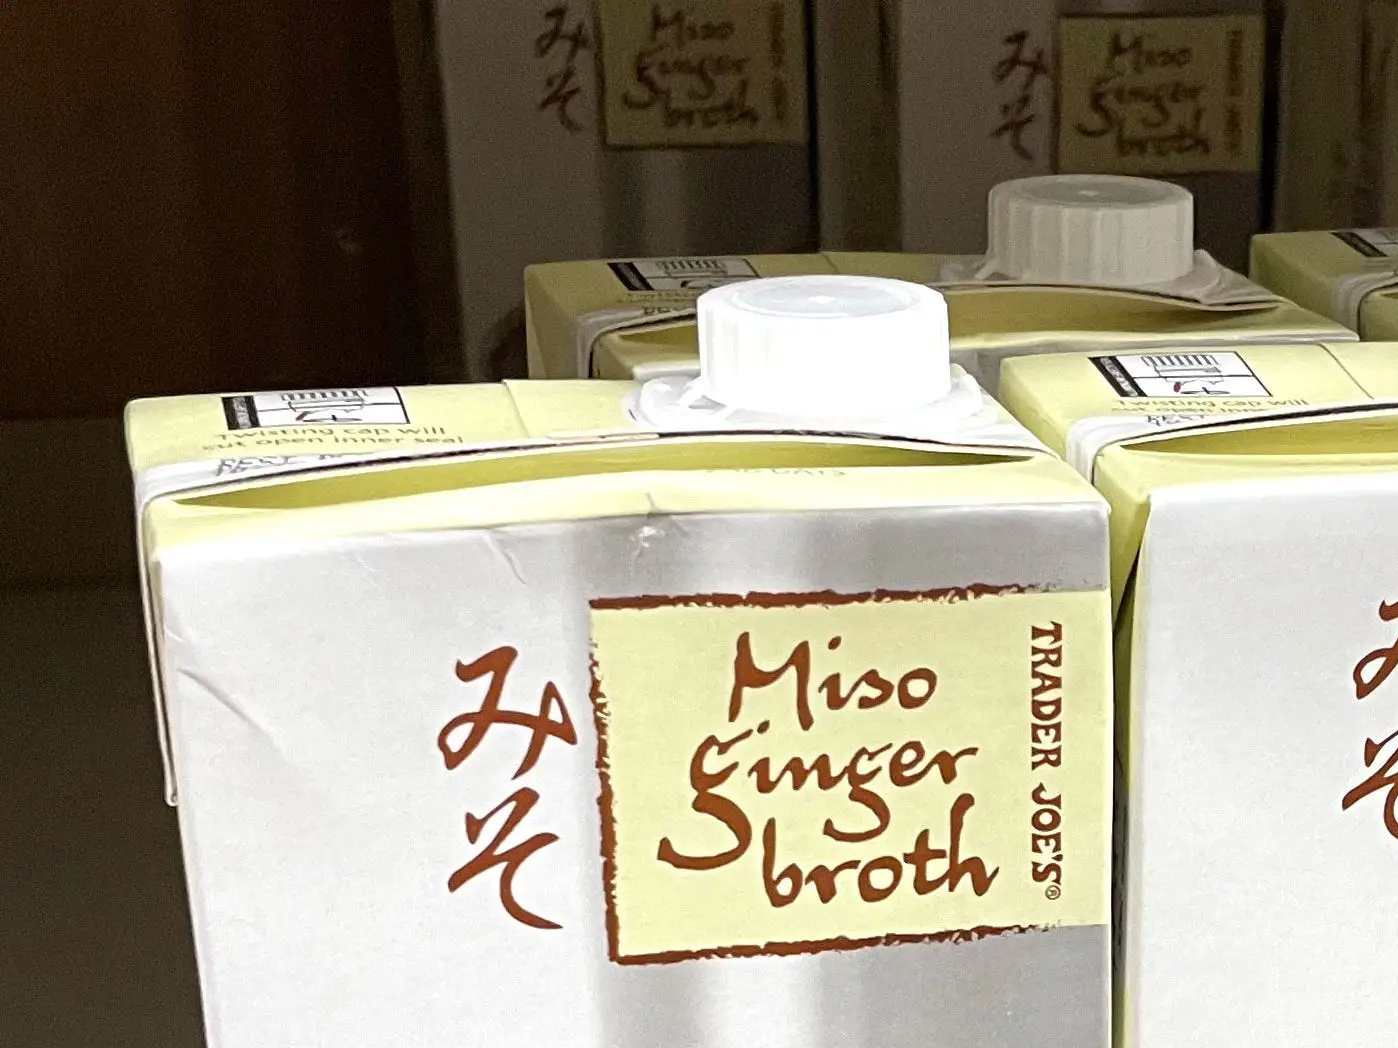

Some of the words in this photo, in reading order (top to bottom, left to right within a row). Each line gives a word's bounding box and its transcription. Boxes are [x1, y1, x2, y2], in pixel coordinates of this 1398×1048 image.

[217, 427, 334, 441] Twisting
[342, 426, 390, 438] cap
[397, 426, 447, 436] will
[255, 436, 323, 447] open
[334, 436, 402, 445] inner
[413, 435, 465, 445] seal
[729, 632, 937, 731] Miso
[1031, 622, 1062, 771] TRADER
[438, 646, 577, 930] みそ
[658, 721, 978, 870] Ginger
[763, 793, 999, 907] broth
